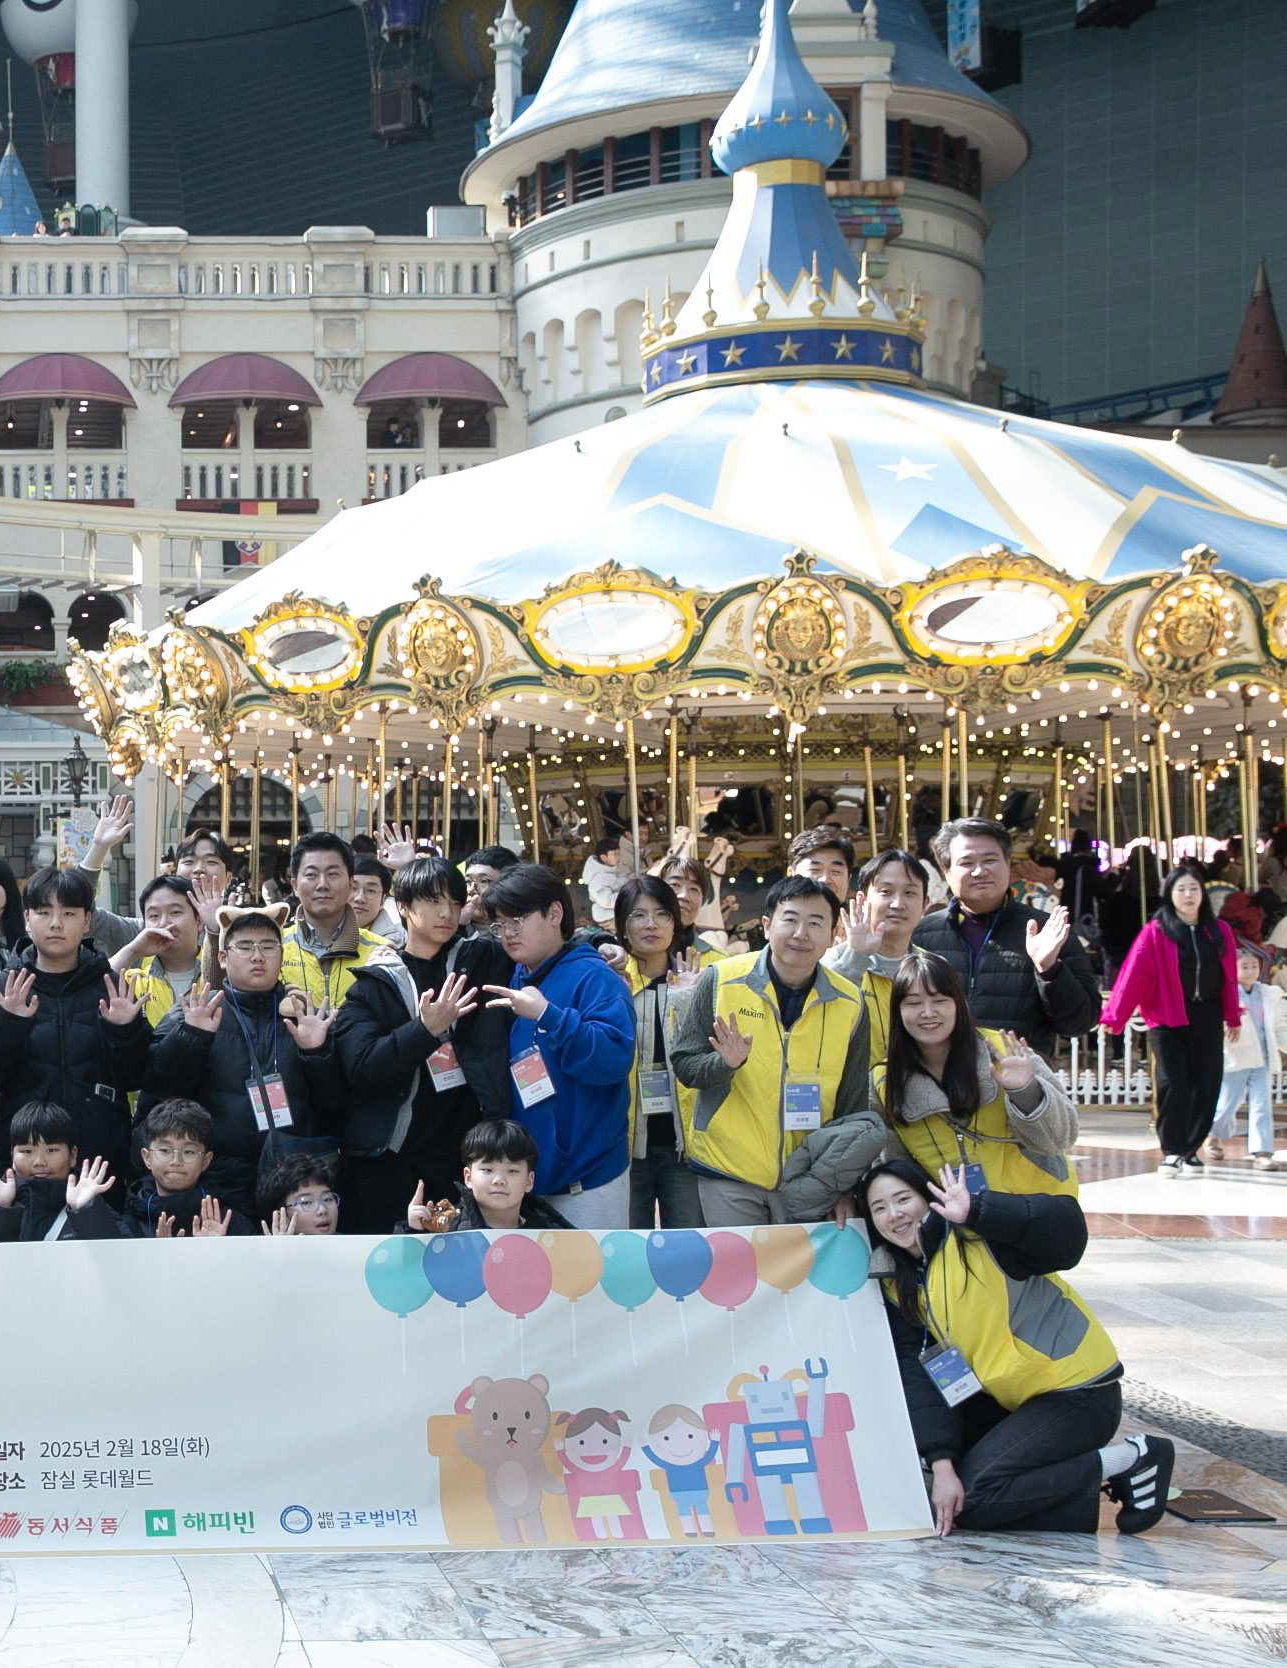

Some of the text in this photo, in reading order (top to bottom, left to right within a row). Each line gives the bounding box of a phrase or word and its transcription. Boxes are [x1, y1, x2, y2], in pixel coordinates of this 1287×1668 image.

[738, 1006, 766, 1020] Maxim
[39, 1439, 101, 1459] 2025년
[106, 1438, 134, 1458] 2월
[140, 1436, 210, 1459] 18일(화)
[40, 1470, 76, 1490] 잠실
[81, 1468, 154, 1490] 롯데월드
[181, 1510, 256, 1534] 해피빈
[317, 1511, 334, 1521] 사단
[317, 1520, 335, 1529] 법인
[336, 1508, 419, 1529] 글로벌비전
[26, 1517, 119, 1536] 동서식품
